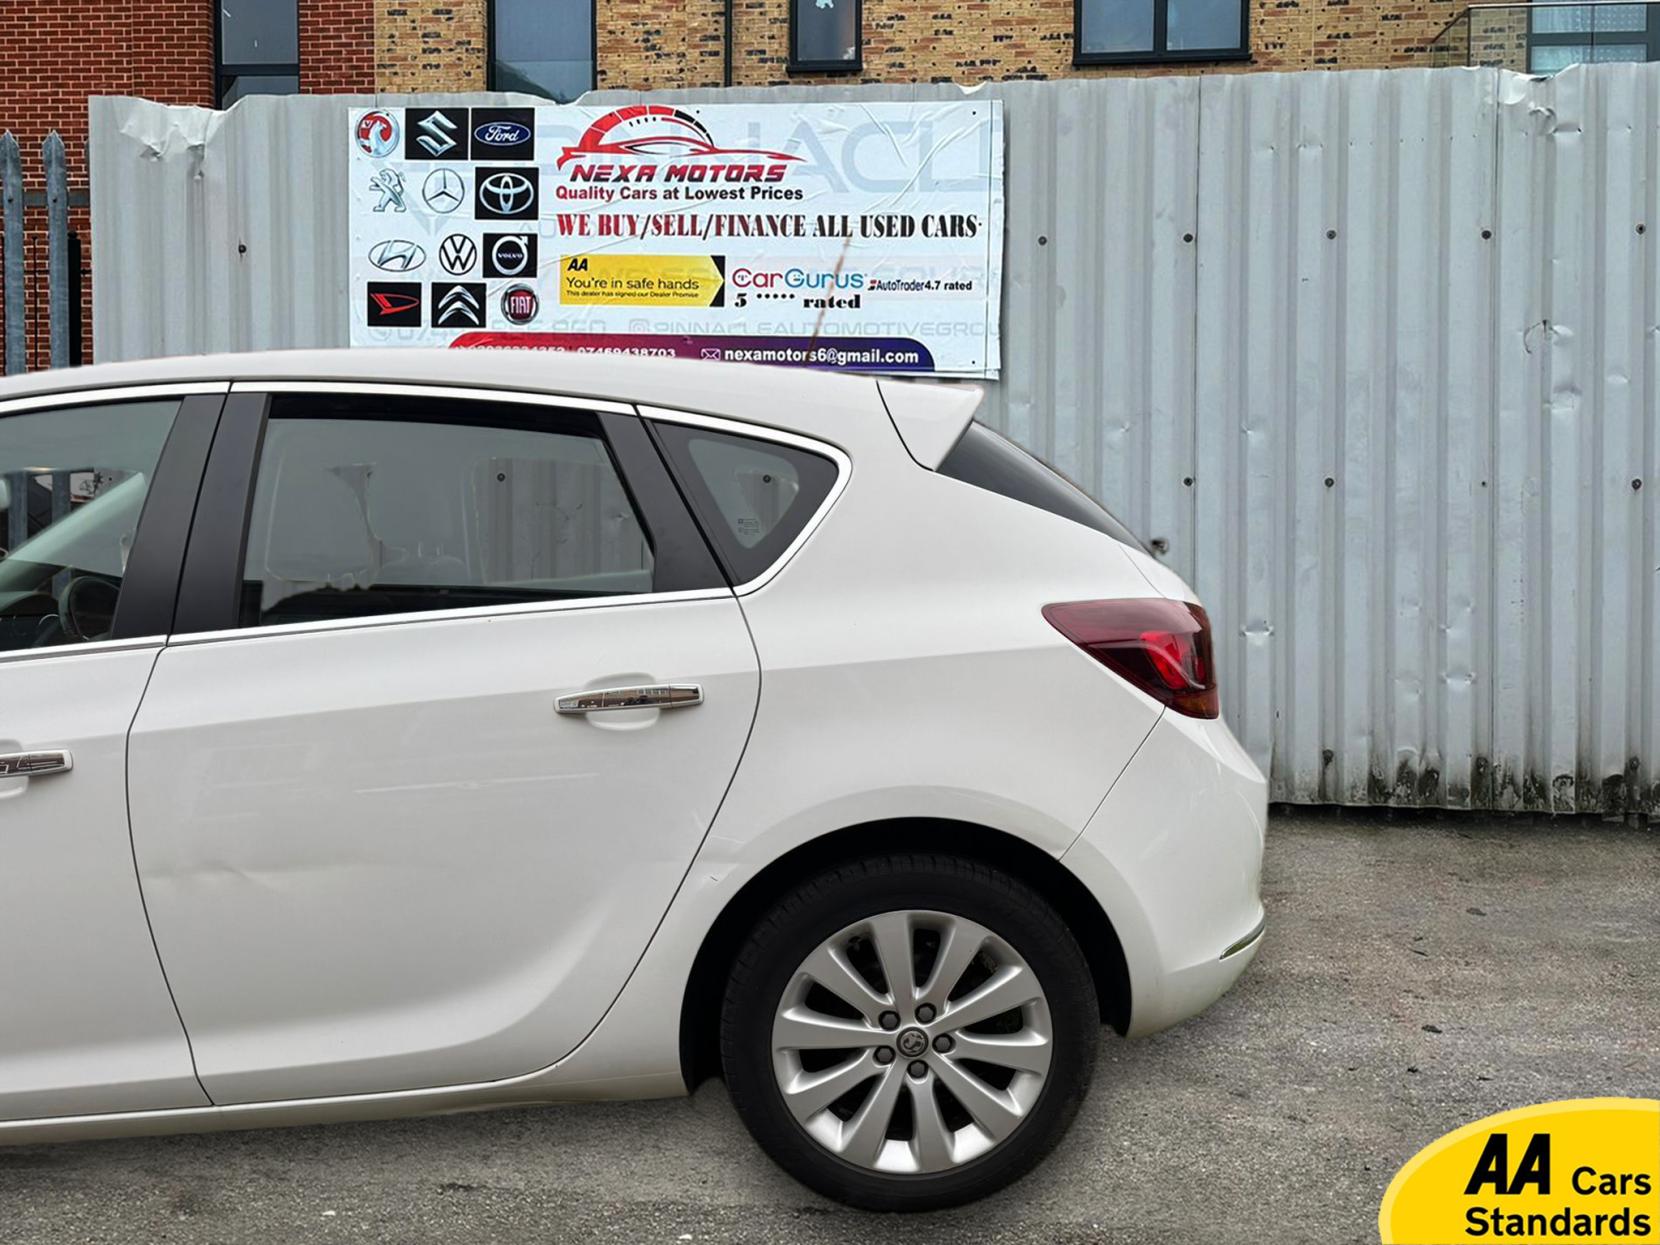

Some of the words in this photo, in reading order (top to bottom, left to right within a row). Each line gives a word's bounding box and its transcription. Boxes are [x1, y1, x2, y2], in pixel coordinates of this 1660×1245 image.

[484, 125, 520, 141] Ford
[570, 164, 658, 183] NEXA
[663, 164, 787, 183] MOTORS
[556, 186, 615, 202] Quality
[620, 186, 657, 200] Cars
[663, 187, 679, 200] at
[685, 187, 745, 200] Lowest
[751, 187, 804, 200] Prices
[556, 213, 591, 237] WE
[597, 213, 806, 240] BUY/SELL/FINANCE
[812, 213, 854, 237] ALL
[860, 214, 915, 238] USED
[921, 214, 978, 238] CARS
[567, 258, 589, 272] AA
[566, 277, 607, 289] You're
[611, 278, 623, 289] in
[626, 278, 655, 290] safe
[658, 278, 699, 290] hands
[732, 267, 864, 289] CarGurus
[943, 280, 973, 291] rated
[510, 295, 532, 314] FIAT
[734, 293, 748, 308] 5
[803, 294, 861, 308] rated
[724, 348, 919, 365] nexamotors6@gmail.com
